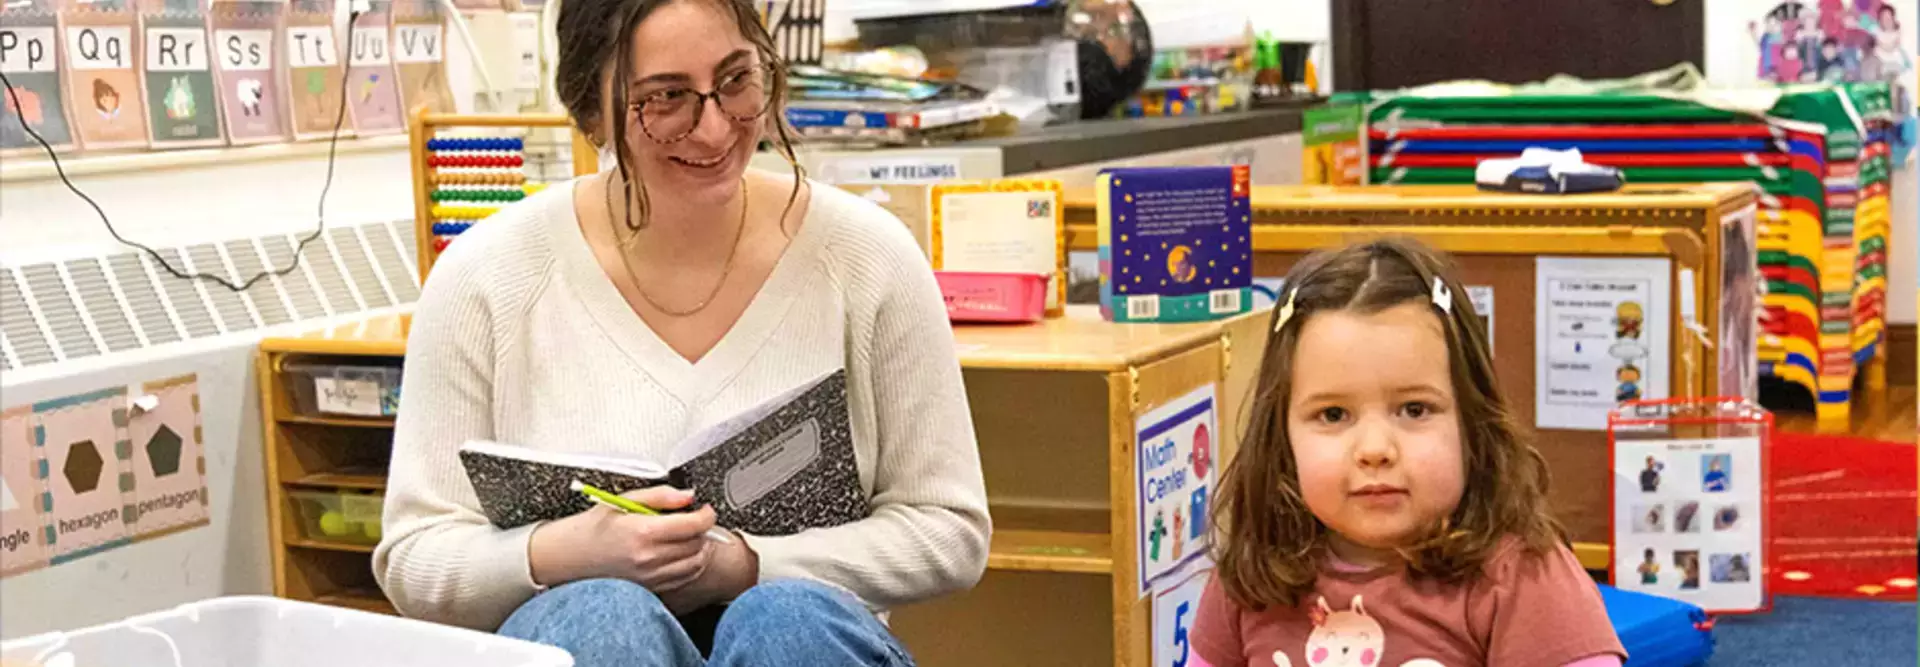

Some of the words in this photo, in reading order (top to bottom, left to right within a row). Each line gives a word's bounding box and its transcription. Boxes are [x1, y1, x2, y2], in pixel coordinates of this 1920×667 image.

[1145, 438, 1176, 472] Math
[138, 488, 199, 517] pentagon
[1147, 468, 1187, 503] Center
[58, 507, 119, 534] hexagon
[1172, 600, 1189, 667] 5
